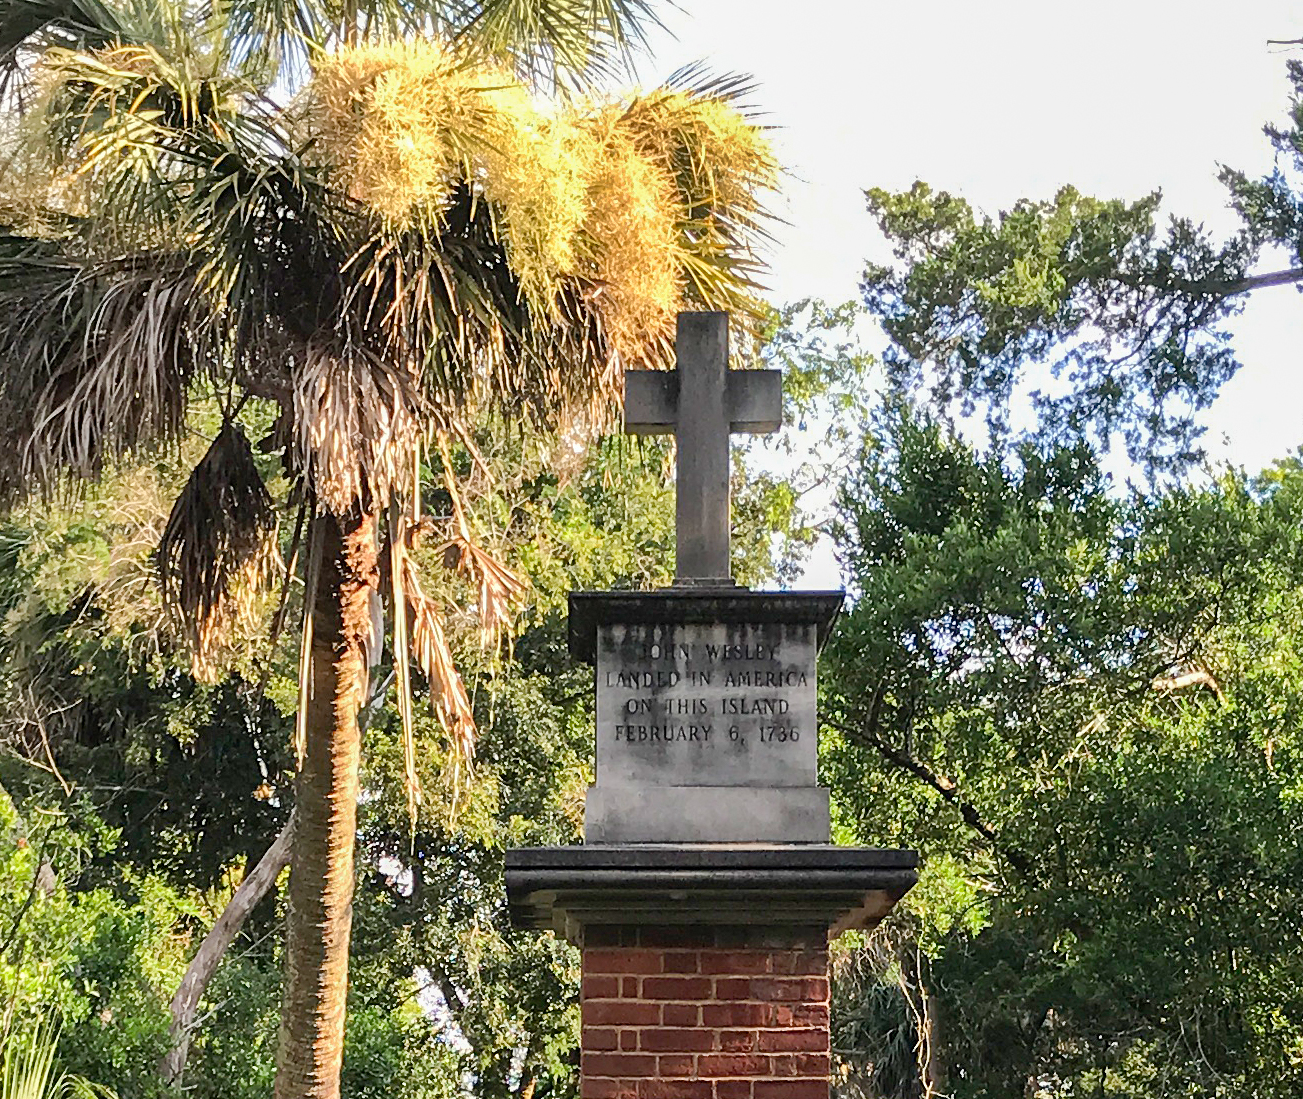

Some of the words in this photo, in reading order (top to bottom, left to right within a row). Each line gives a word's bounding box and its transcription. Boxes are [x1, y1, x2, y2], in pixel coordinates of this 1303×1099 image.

[705, 643, 775, 661] WESLEY
[606, 671, 681, 689] LANDED
[692, 671, 711, 689] IN
[724, 671, 808, 688] AMERICA
[627, 698, 651, 715] ON
[666, 698, 708, 715] THIS
[722, 698, 789, 716] ISLAND
[615, 725, 712, 742] FEBRUARY
[729, 725, 745, 745] 6,
[760, 726, 800, 743] 1736
